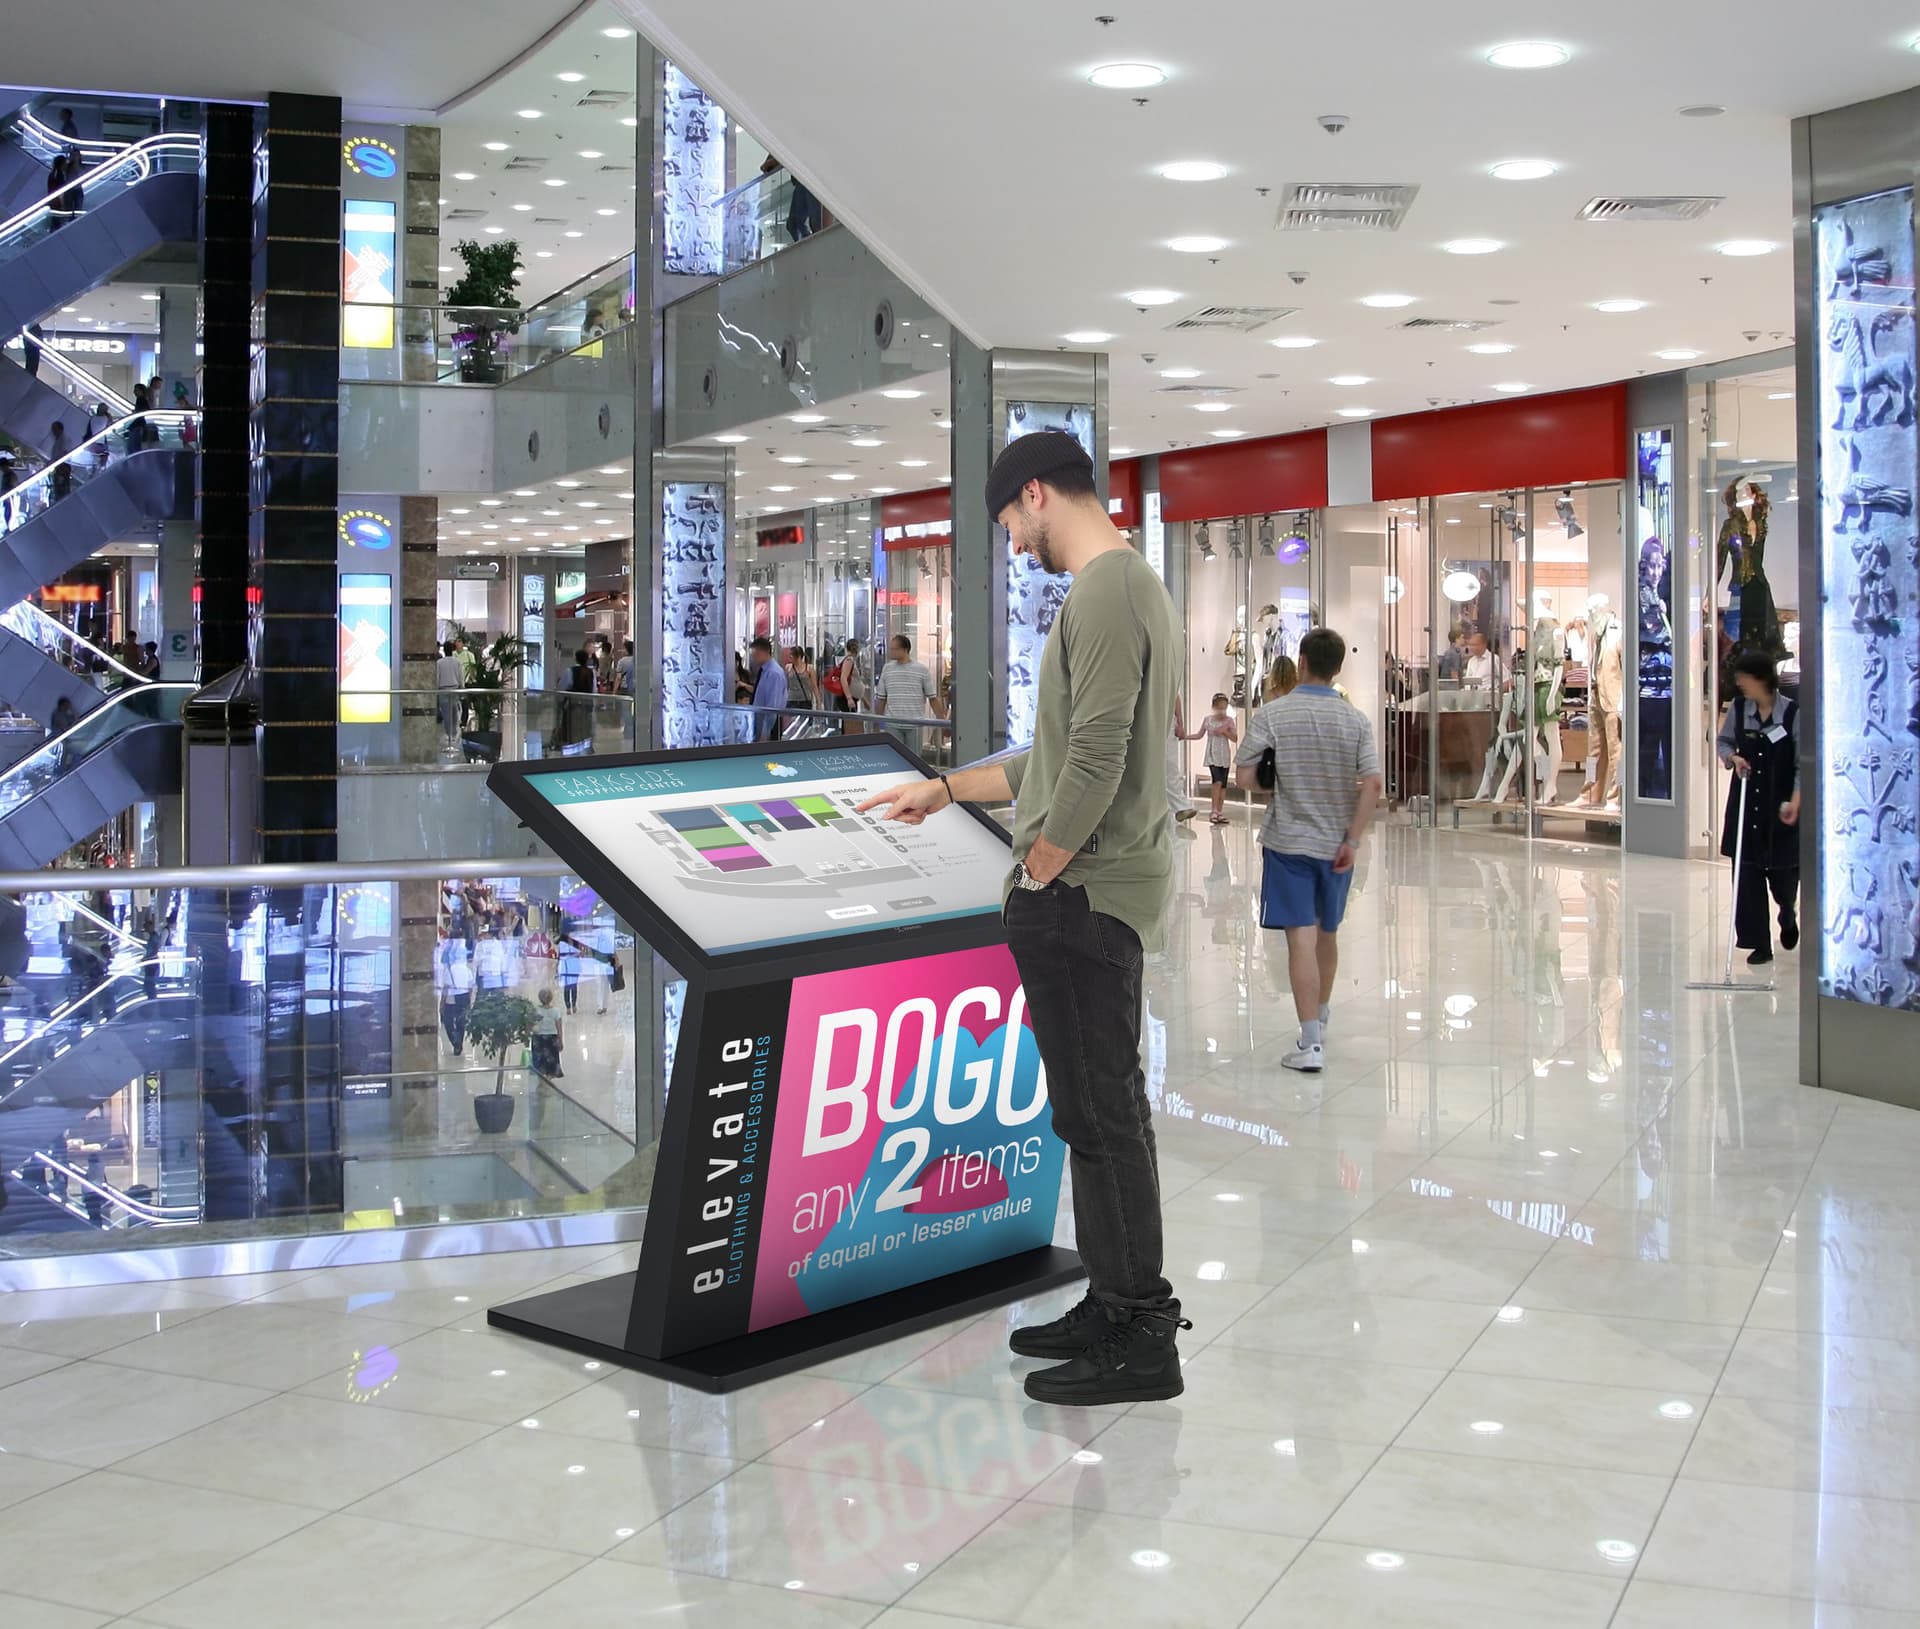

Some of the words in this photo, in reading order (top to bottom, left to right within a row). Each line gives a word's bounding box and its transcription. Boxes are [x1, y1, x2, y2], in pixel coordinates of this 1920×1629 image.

[554, 768, 681, 791] PARKSIDE
[567, 785, 634, 797] SHOPPING
[639, 780, 687, 791] CENTER
[742, 1035, 771, 1164] ACCESSORIES
[686, 1037, 754, 1294] elevate
[740, 1173, 754, 1184] &
[792, 1177, 871, 1234] any
[874, 1127, 931, 1213] 2
[938, 1136, 1042, 1196] items
[727, 1192, 751, 1284] CLOTHING
[788, 1252, 813, 1279] of
[818, 1234, 877, 1269] equal
[883, 1231, 907, 1249] or
[912, 1212, 976, 1244] lesser
[982, 1197, 1032, 1225] value
